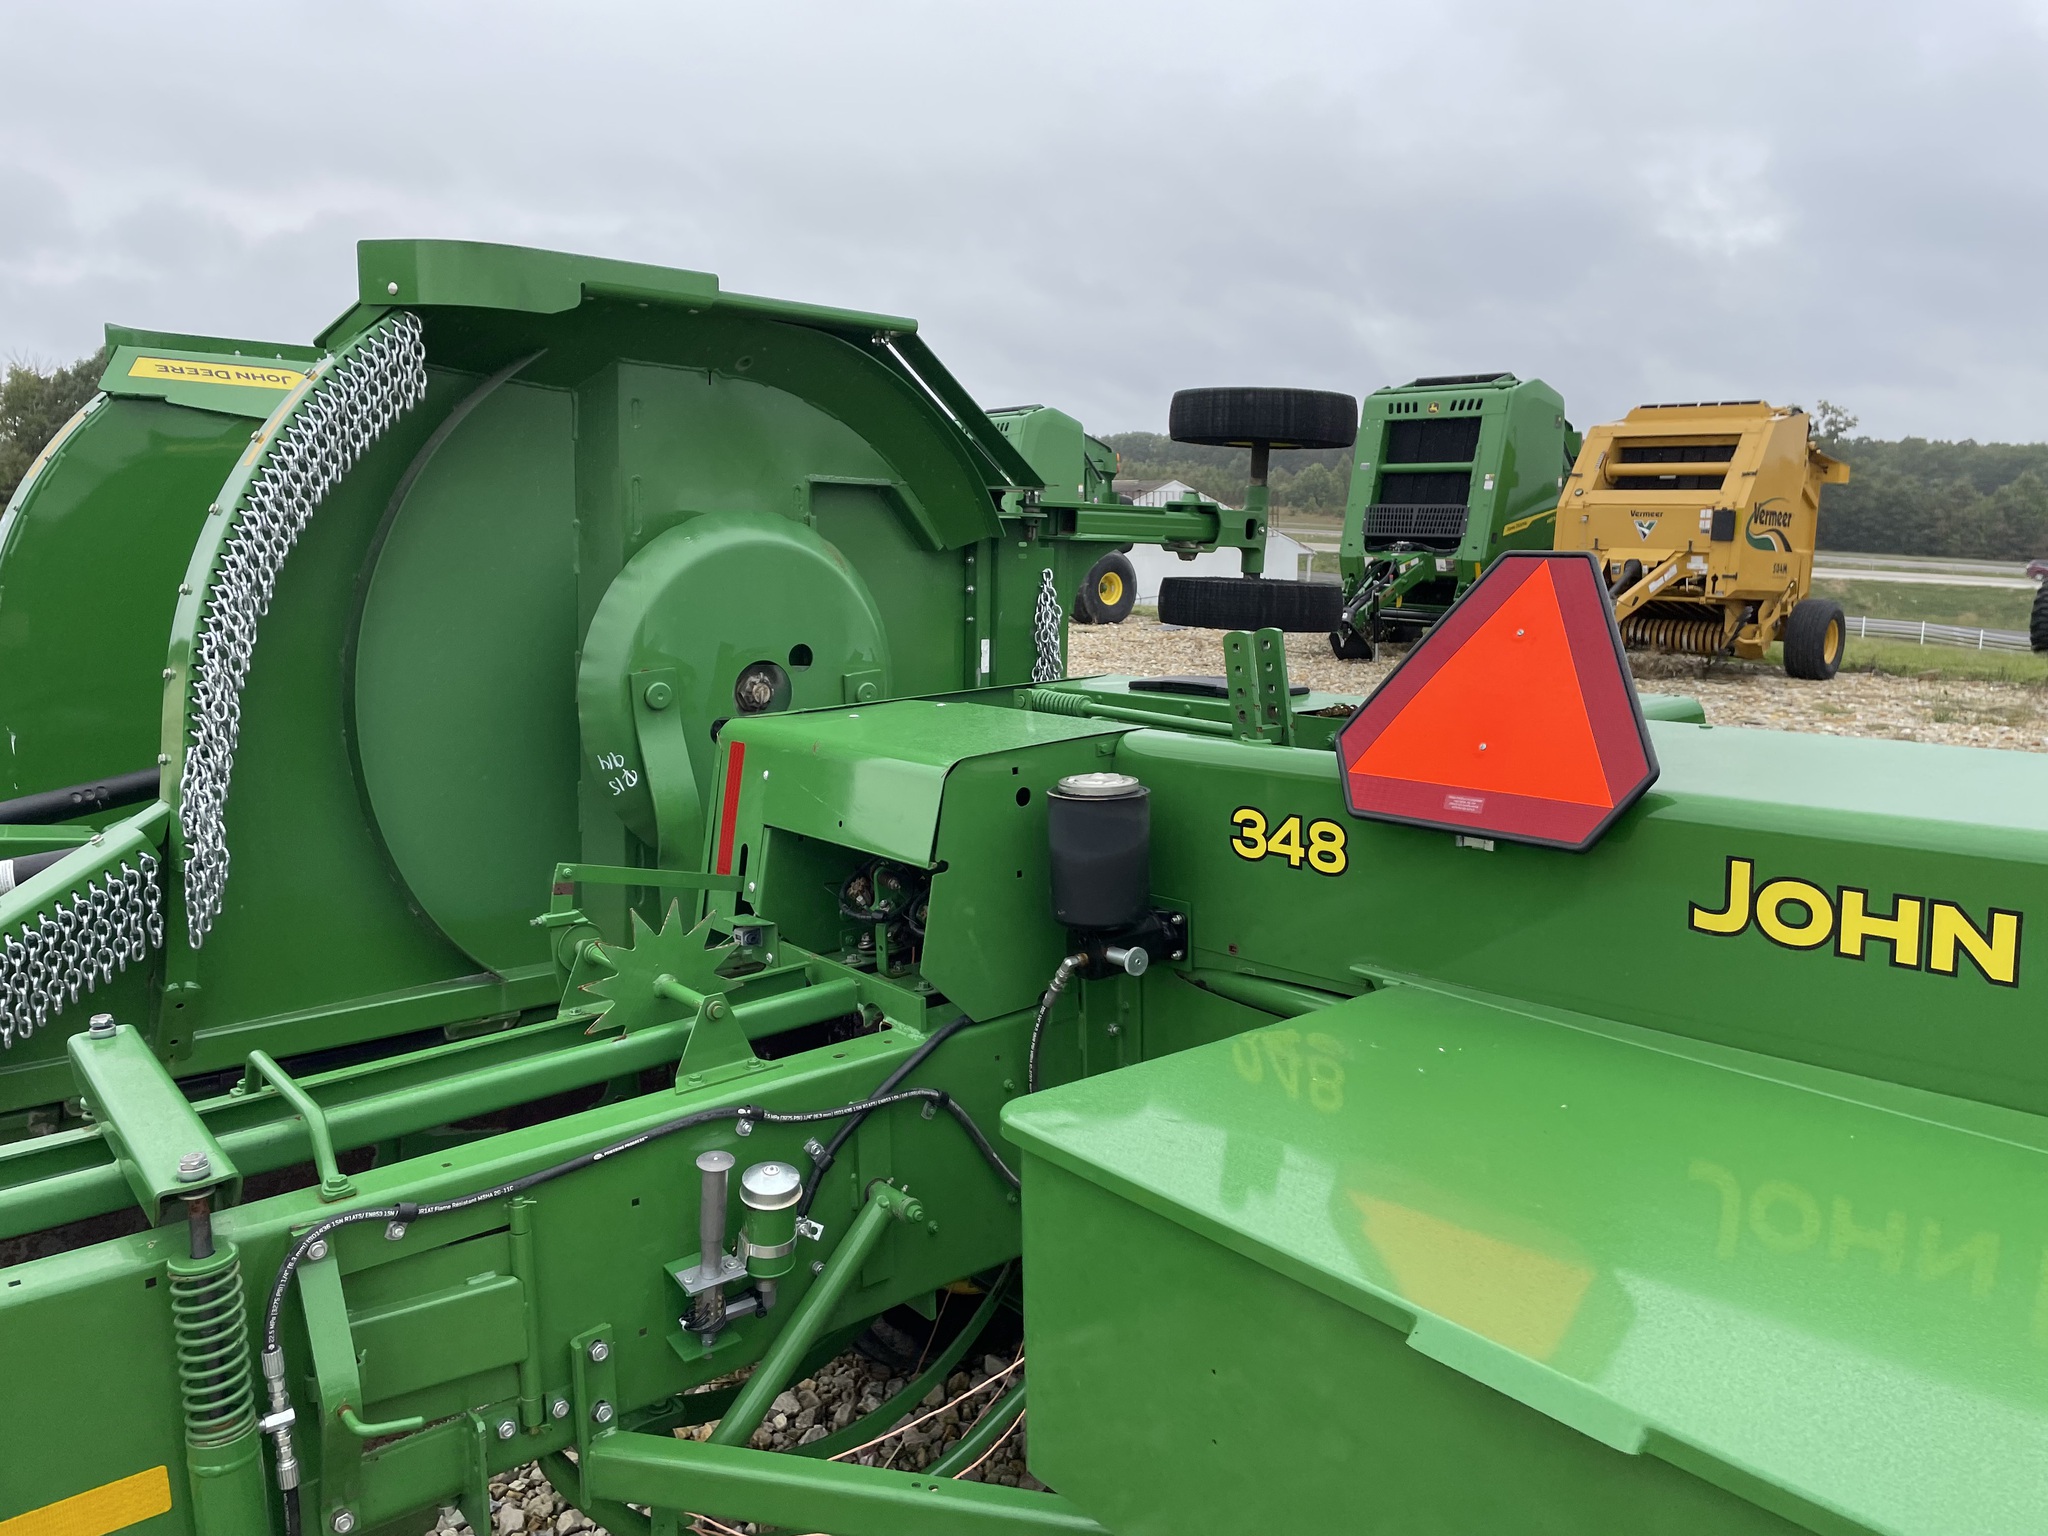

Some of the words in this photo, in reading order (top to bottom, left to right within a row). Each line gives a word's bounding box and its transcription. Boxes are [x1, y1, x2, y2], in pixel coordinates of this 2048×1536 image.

[155, 364, 231, 380] DEERE
[236, 371, 292, 386] JOHN
[1630, 509, 1664, 518] Vermeer
[1753, 502, 1792, 529] Vermeer
[1228, 805, 1349, 877] 348
[1689, 857, 2020, 985] JOHN
[434, 1204, 452, 1212] Flame
[451, 1197, 477, 1208] Resistant
